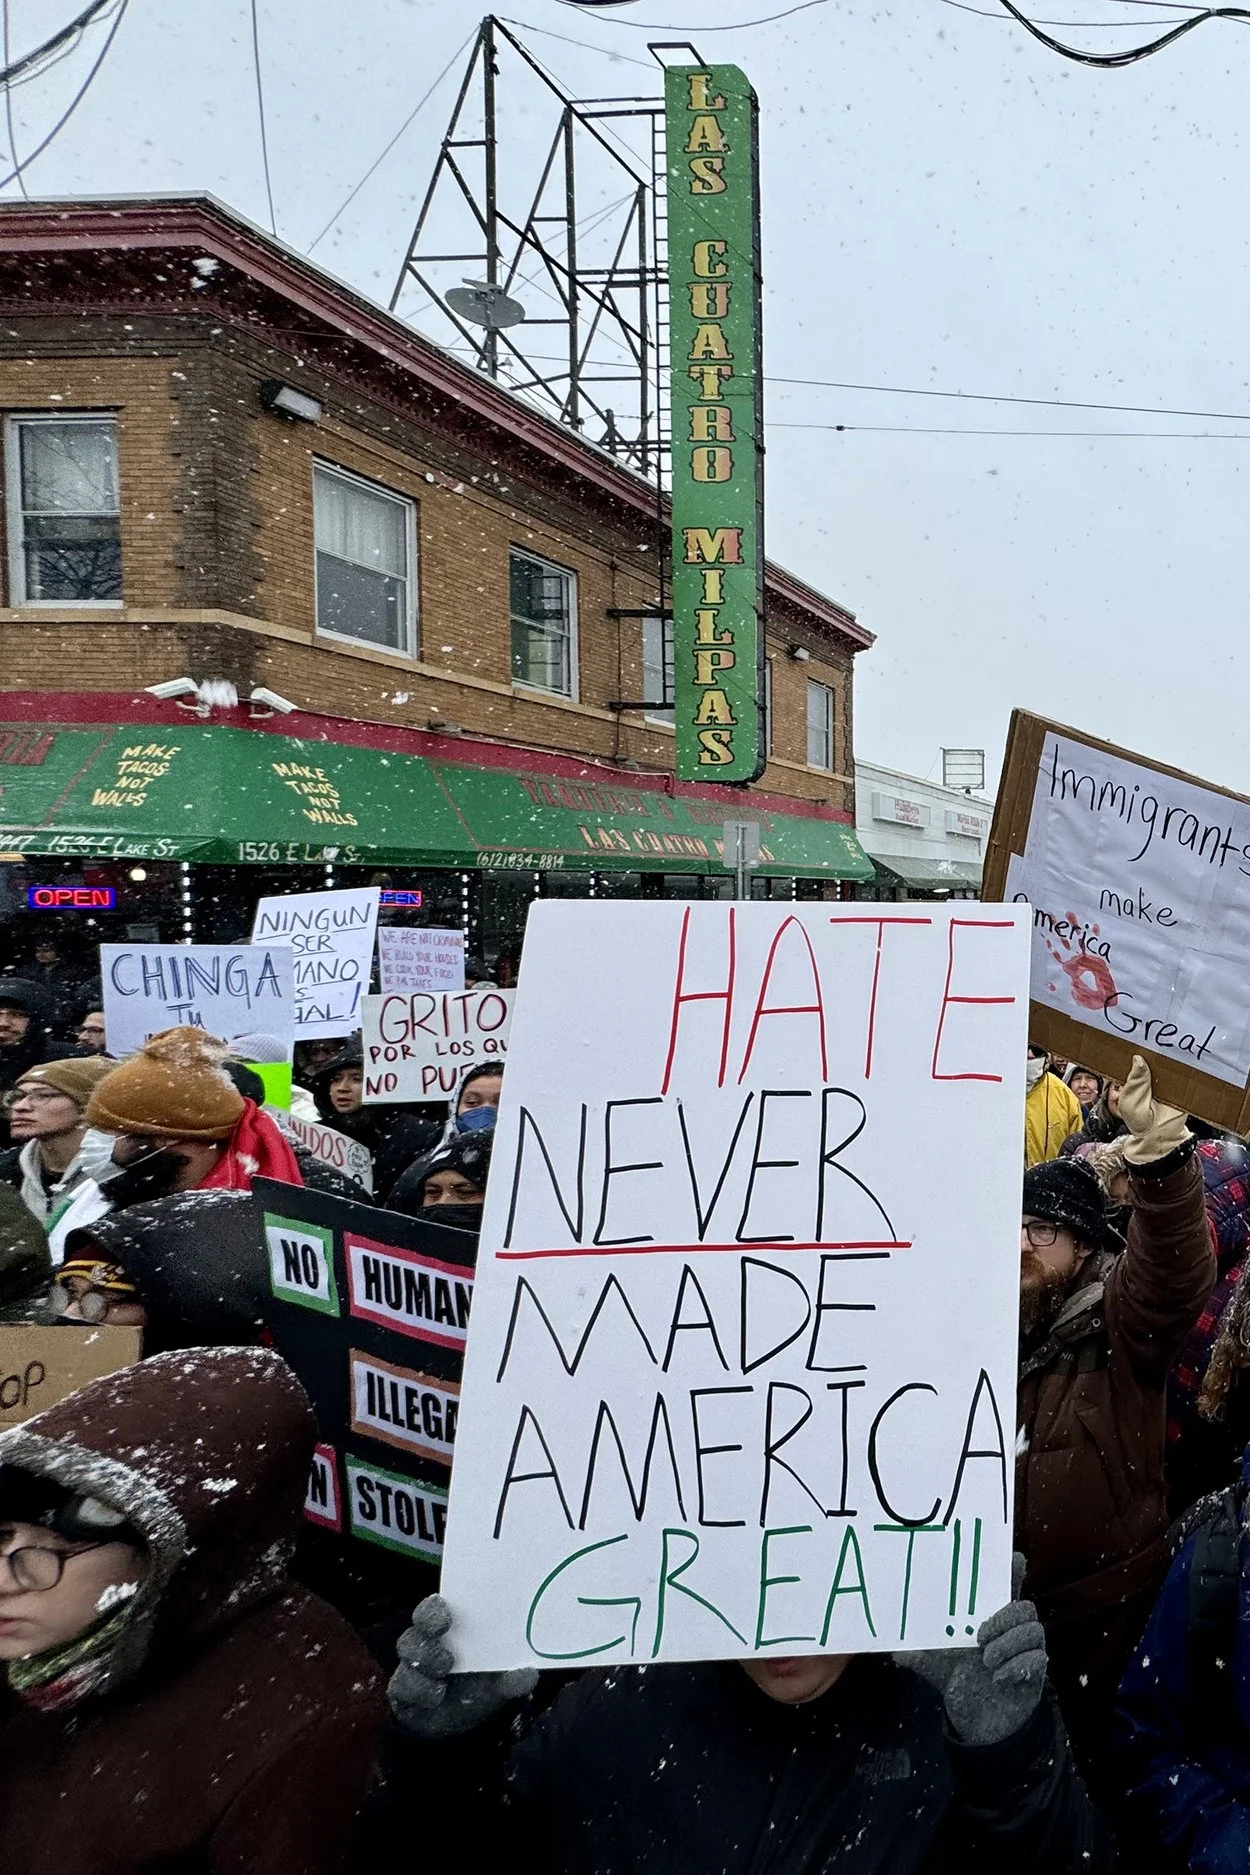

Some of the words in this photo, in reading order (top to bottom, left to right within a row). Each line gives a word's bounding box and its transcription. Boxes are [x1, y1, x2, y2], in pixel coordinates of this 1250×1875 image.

[684, 73, 731, 196] LAS
[686, 239, 736, 484] CUATRO
[682, 527, 744, 766] MILPAS
[121, 743, 182, 760] MAKE
[117, 761, 171, 777] TACOS
[272, 762, 330, 782] MAKE
[115, 776, 155, 789] NOT
[284, 781, 341, 799] TACOS
[90, 788, 148, 807] WALLS
[308, 796, 342, 810] NOT
[302, 808, 359, 827] WALLS
[577, 825, 632, 851] LAS
[238, 842, 281, 861] 1526
[286, 842, 300, 861] E
[34, 889, 110, 906] OPEN
[379, 892, 419, 904] PEN
[1100, 887, 1178, 928] make
[291, 933, 334, 954] SER
[111, 951, 283, 1010] CHINGA
[660, 905, 1017, 1096] HATE
[379, 991, 508, 1045] GRITO
[1103, 991, 1217, 1061] Great
[369, 1044, 416, 1064] POR
[435, 1039, 475, 1056] LOS
[365, 1072, 398, 1096] NO
[503, 1086, 897, 1249] NEVER
[280, 1238, 320, 1290] NO
[496, 1252, 891, 1383] MADE
[494, 1368, 1009, 1540] AMERICA
[526, 1518, 982, 1661] GREAT!!
